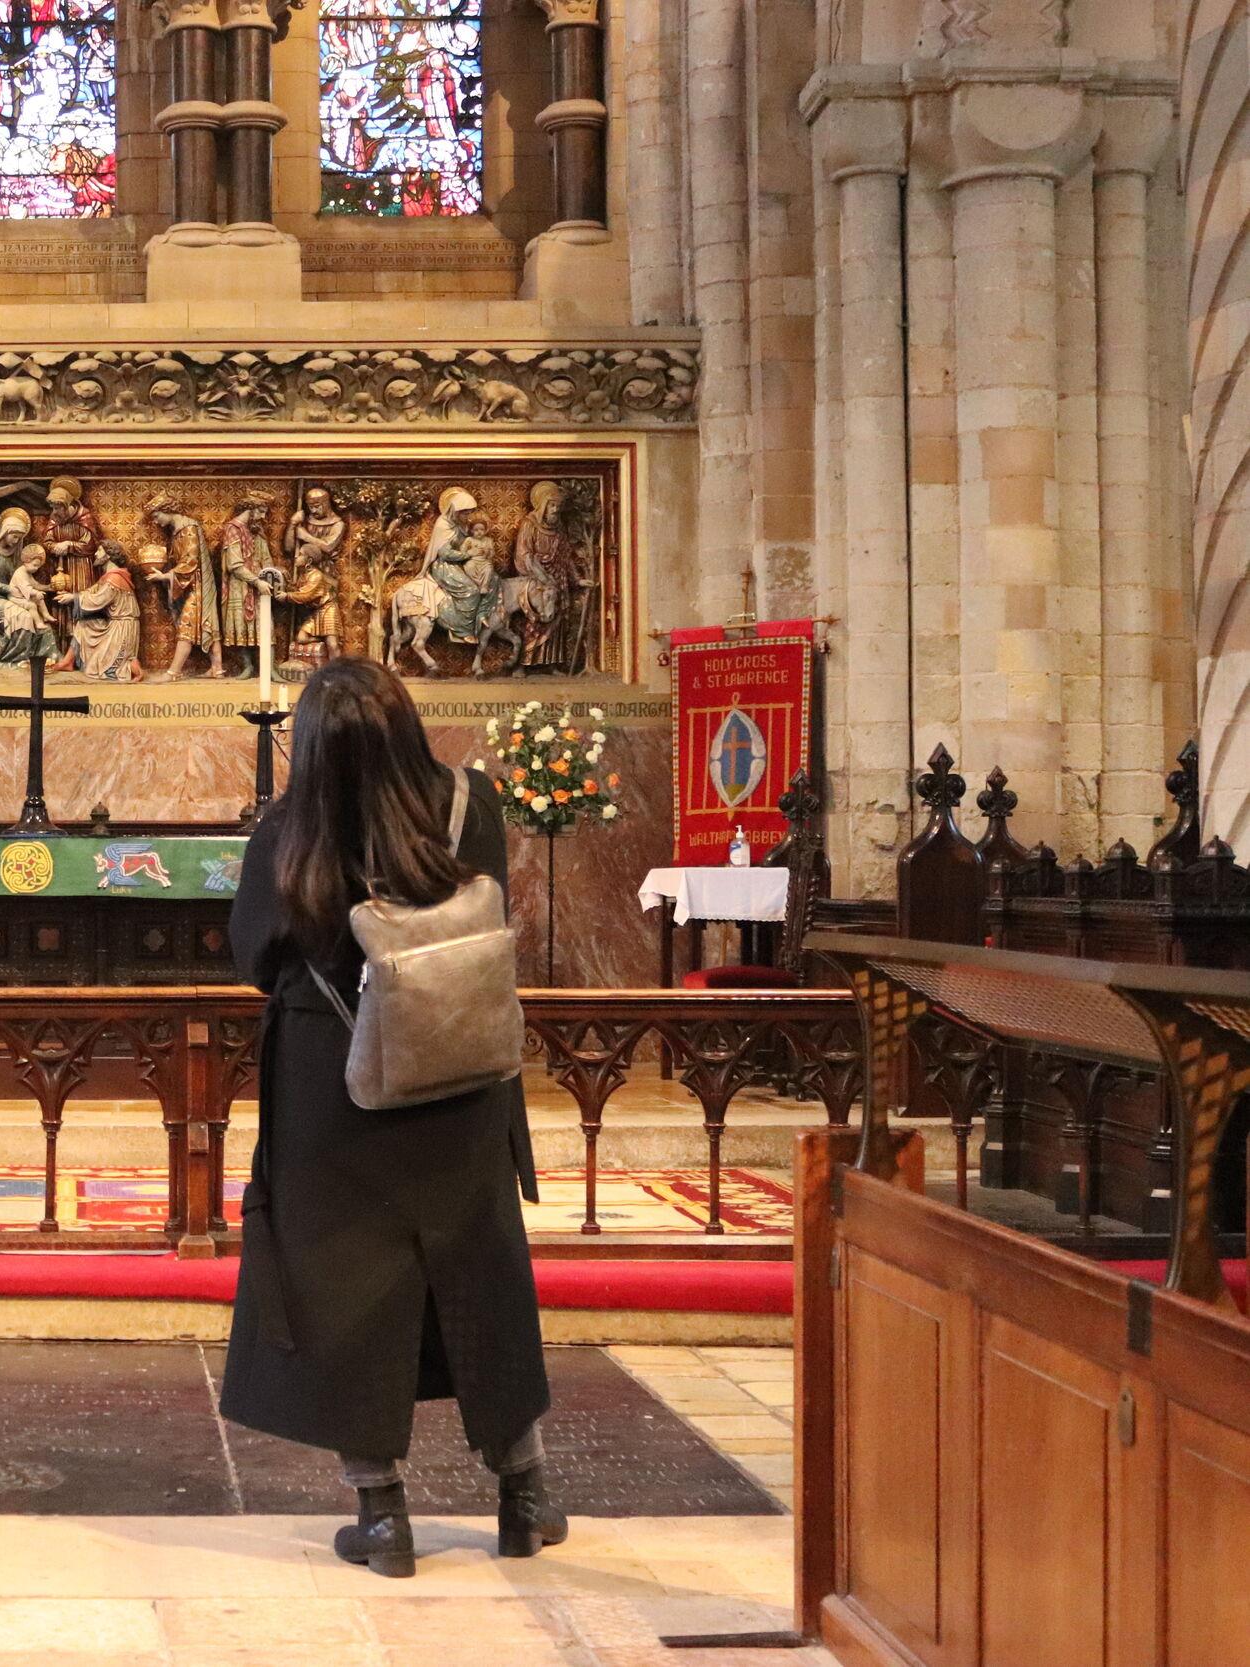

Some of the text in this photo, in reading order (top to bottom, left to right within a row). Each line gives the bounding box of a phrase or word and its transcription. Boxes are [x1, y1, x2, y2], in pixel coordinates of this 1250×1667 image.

[704, 654, 777, 673] HOLY CROSS
[692, 670, 789, 689] & ST LAWRENCE
